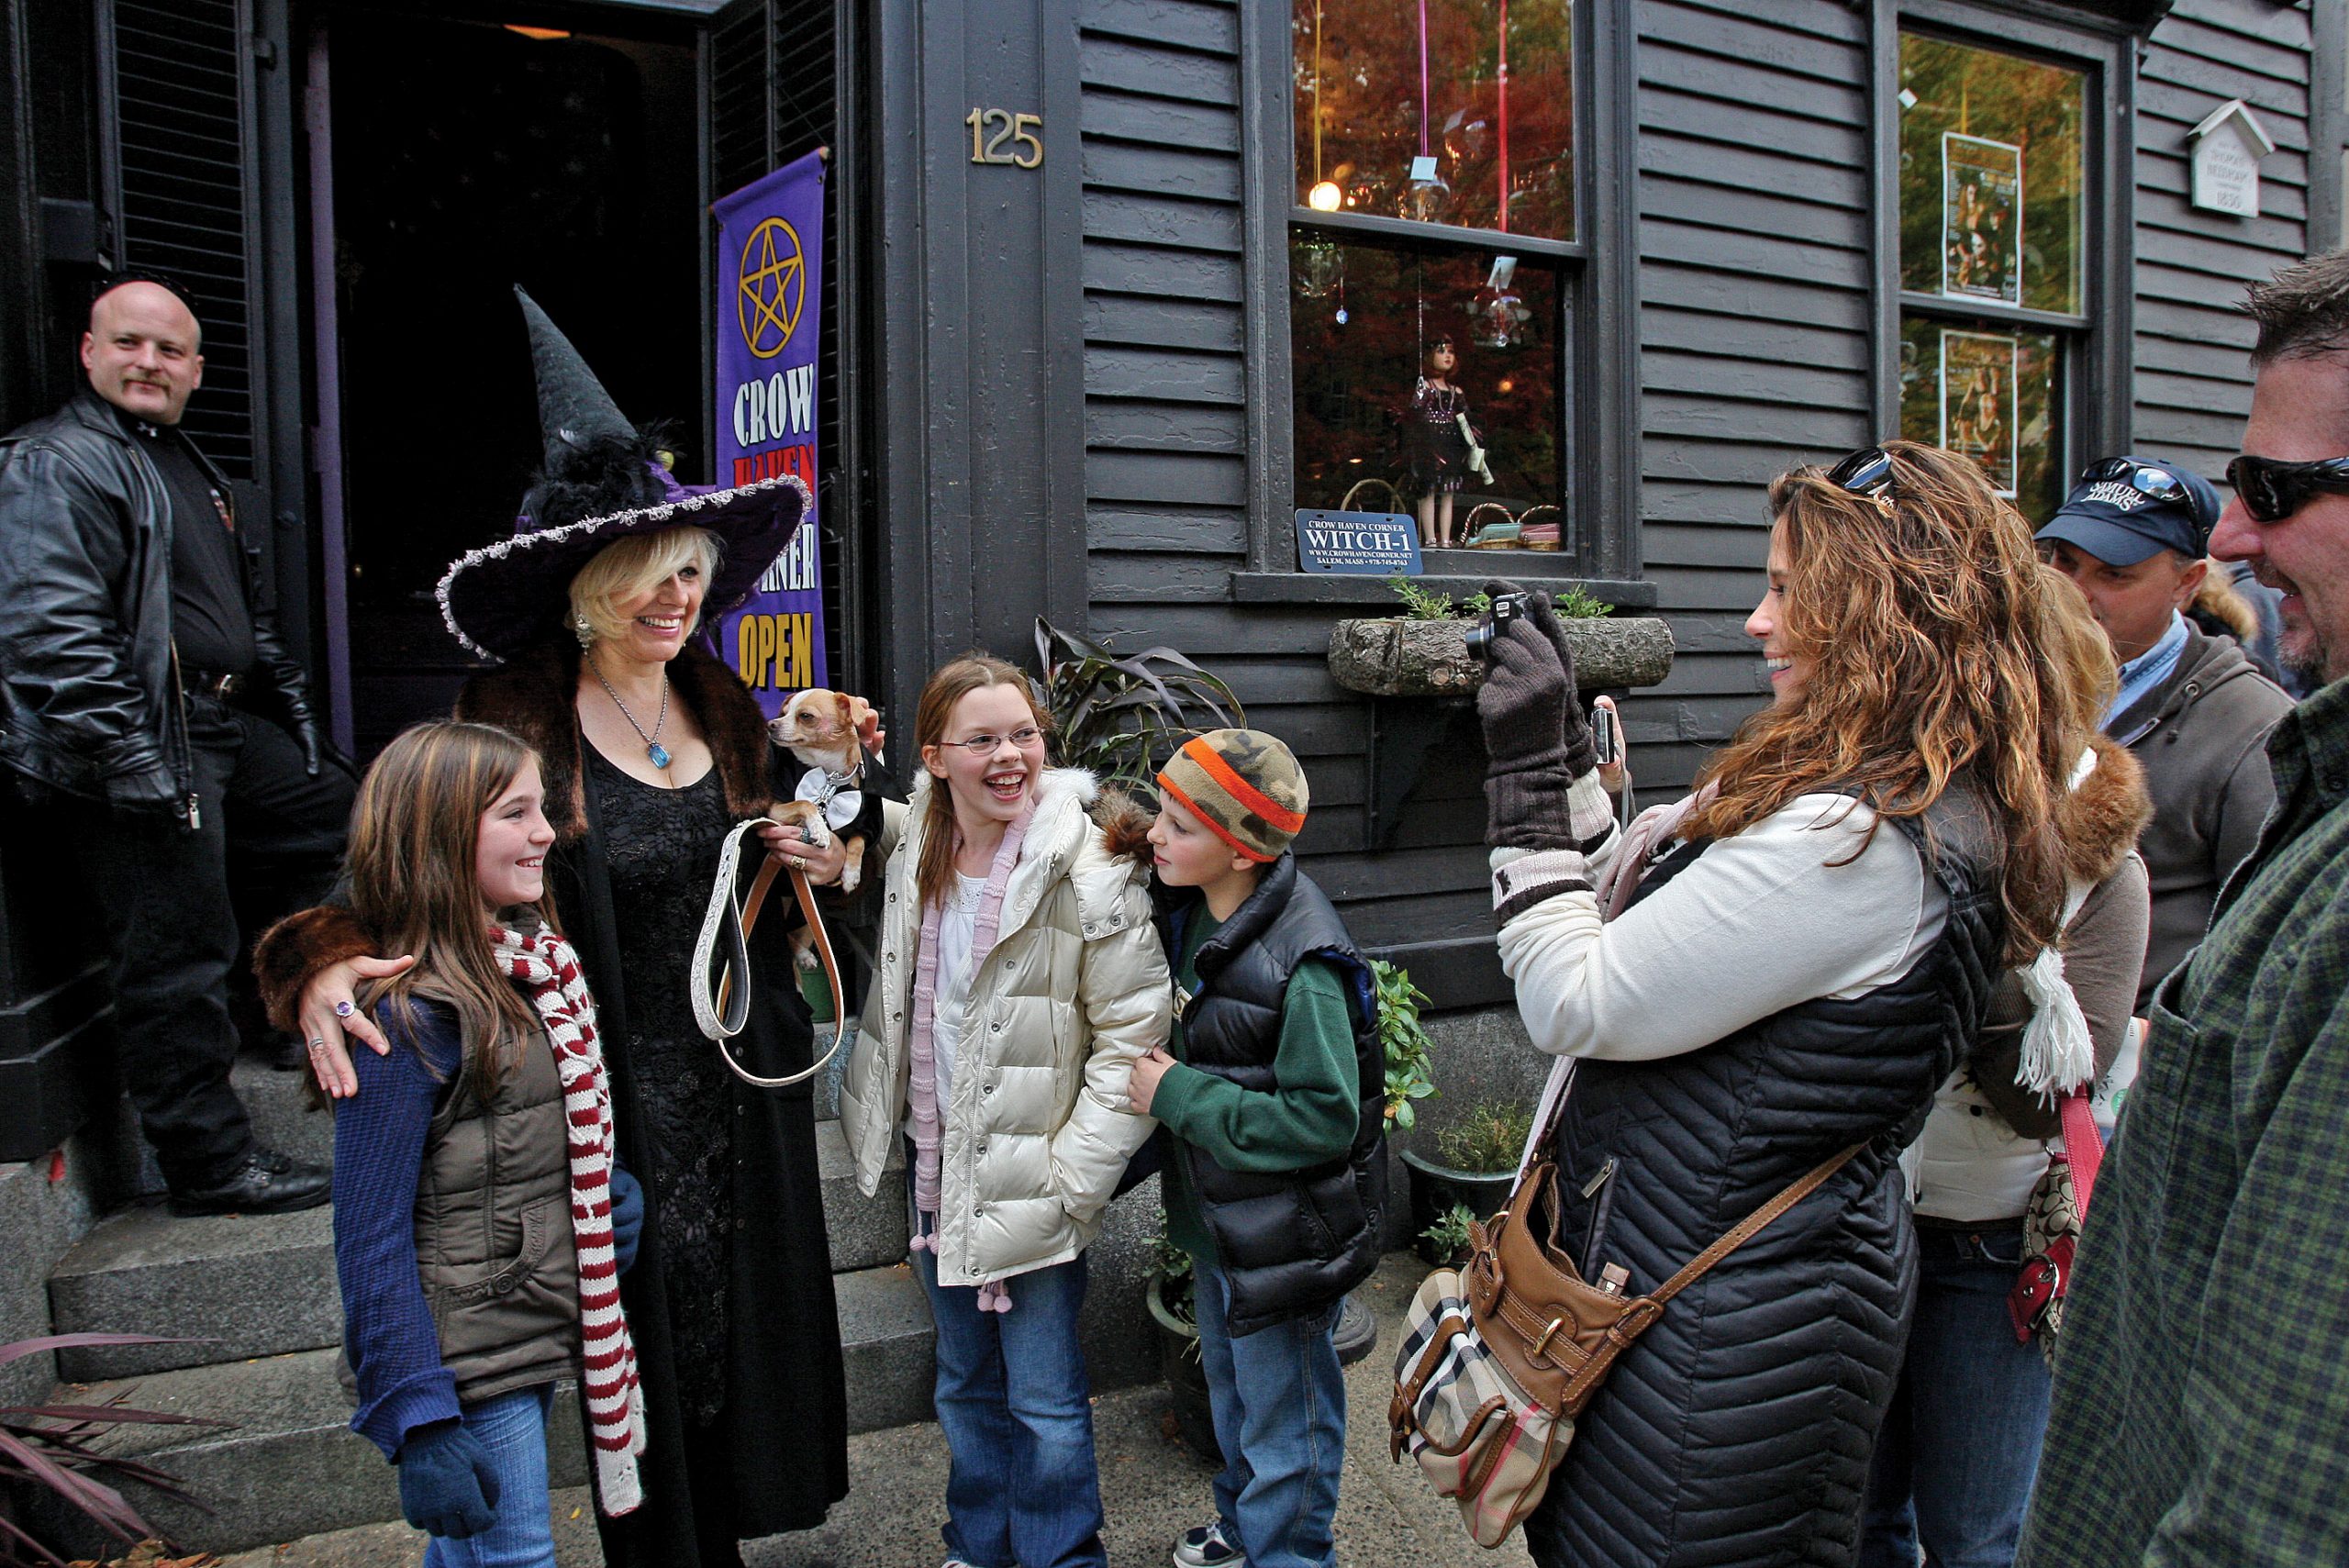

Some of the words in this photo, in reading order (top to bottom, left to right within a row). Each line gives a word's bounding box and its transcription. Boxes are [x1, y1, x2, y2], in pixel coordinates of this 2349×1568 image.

[966, 107, 1043, 169] 125
[733, 362, 814, 448] CROW
[2080, 491, 2131, 512] ADAMS
[2089, 481, 2145, 505] SAMUEL
[1308, 519, 1336, 529] CROW
[1338, 521, 1367, 530] HAVEN
[1369, 523, 1406, 532] CORNER
[1305, 529, 1412, 551] WITCH-1
[738, 612, 811, 689] OPEN
